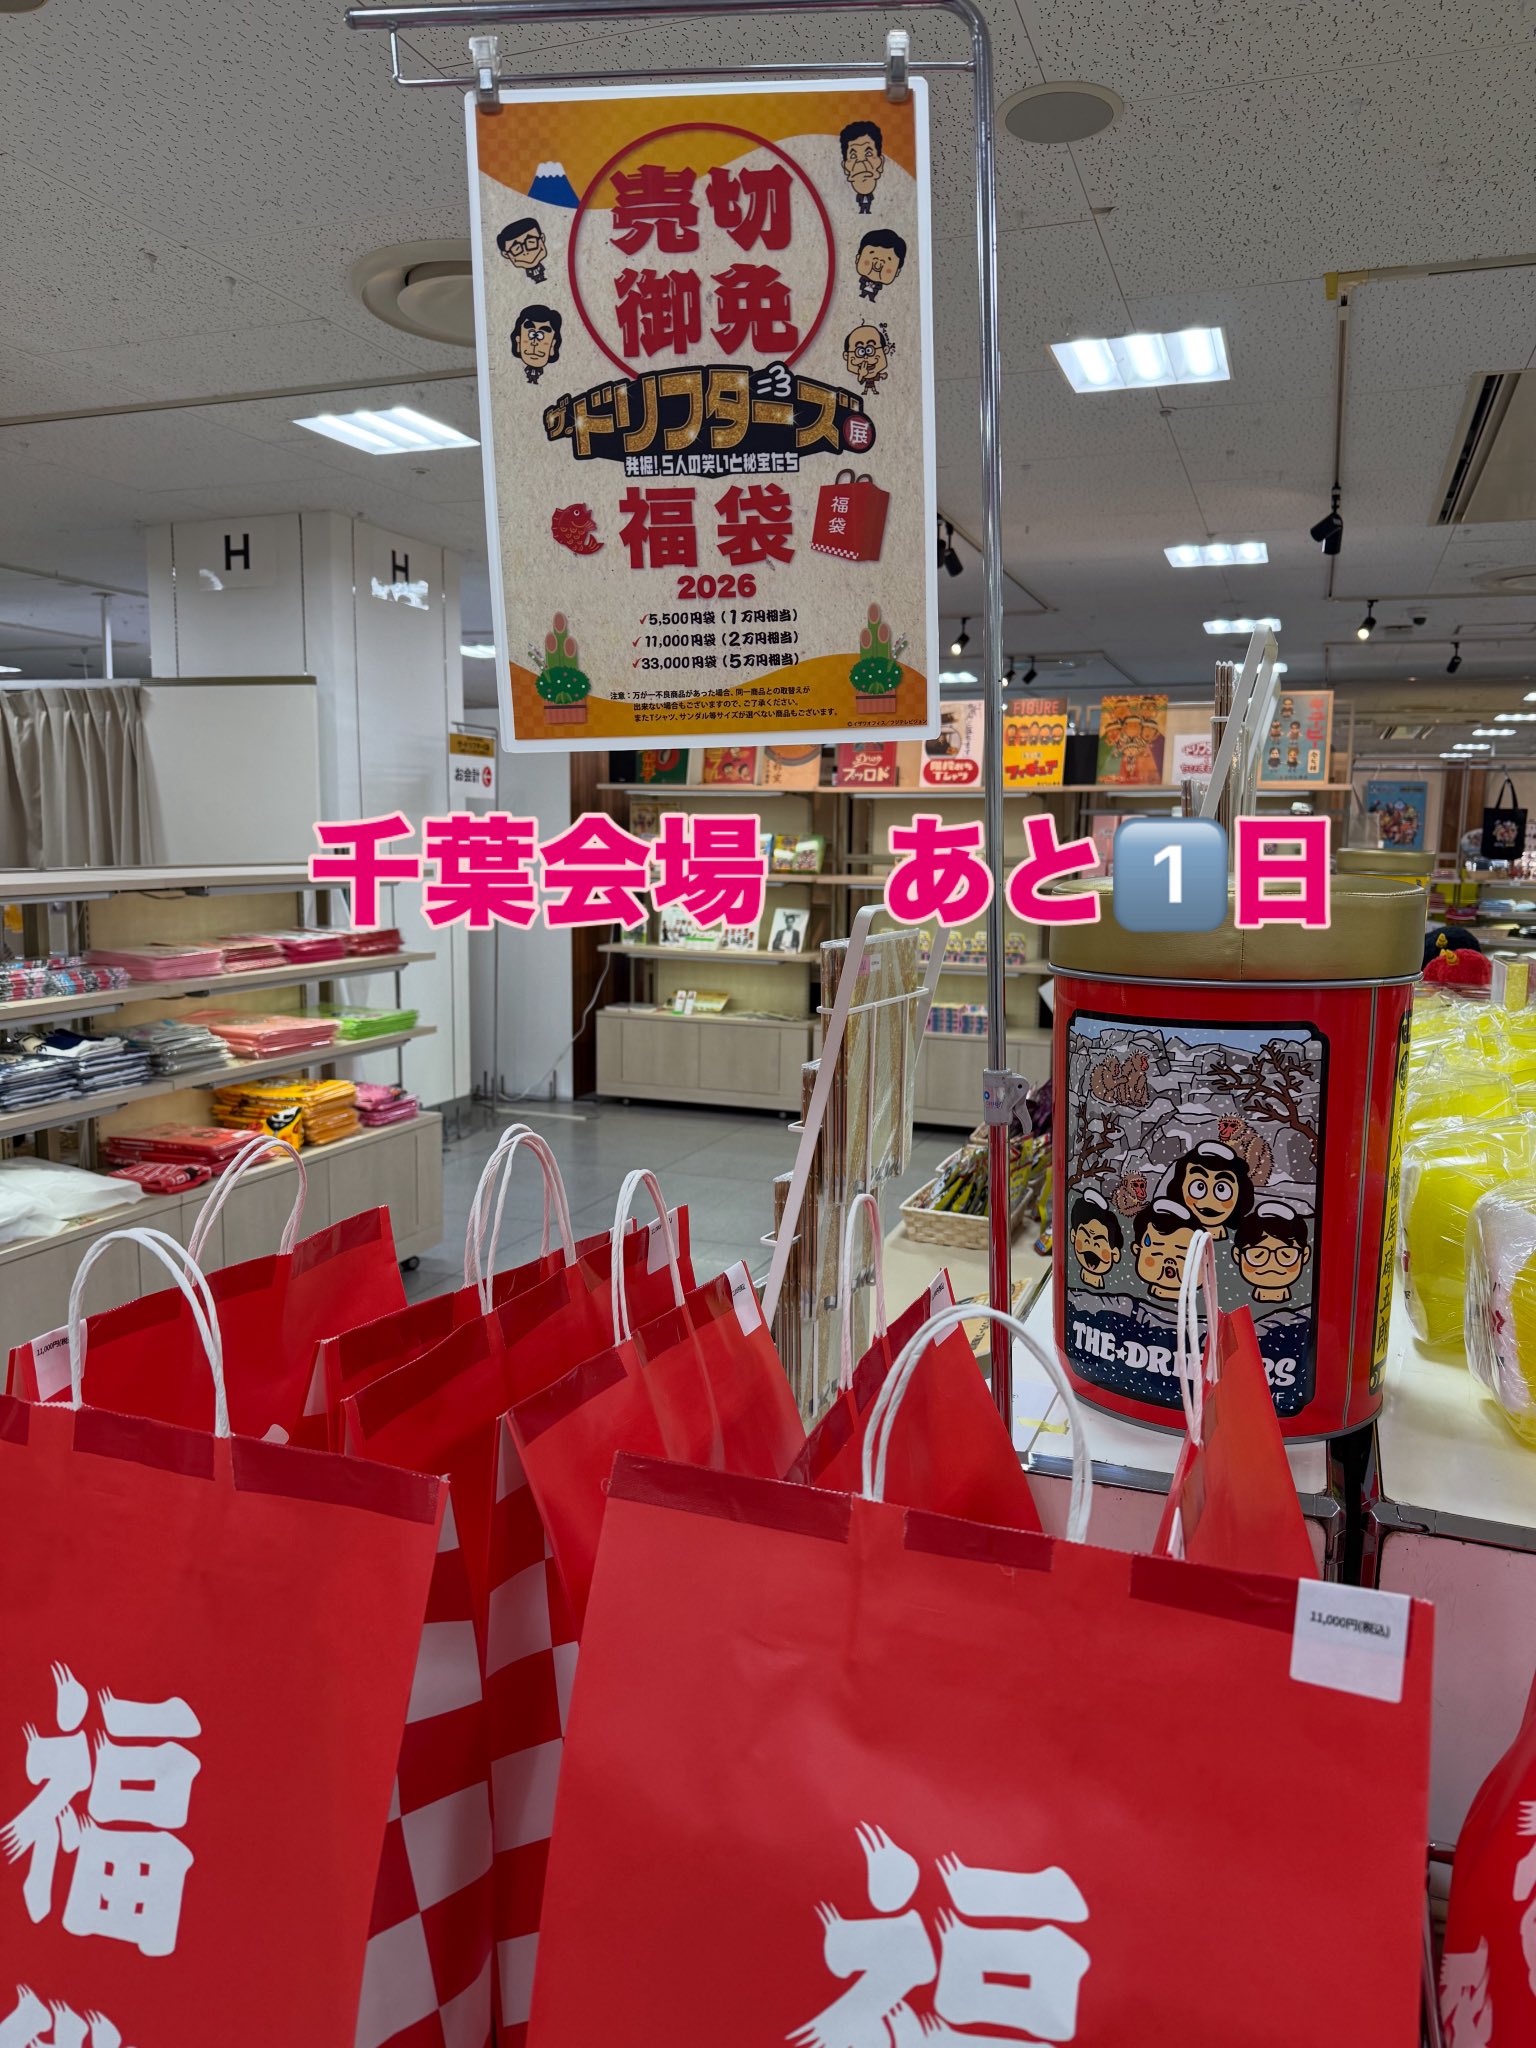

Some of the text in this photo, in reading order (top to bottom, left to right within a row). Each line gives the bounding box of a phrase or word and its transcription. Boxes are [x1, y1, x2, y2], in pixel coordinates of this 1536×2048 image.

[610, 164, 794, 256] 売切
[614, 262, 799, 358] 御免
[619, 482, 796, 570] 福袋
[827, 495, 850, 535] 福袋
[224, 533, 251, 571] H
[391, 550, 410, 583] H
[677, 573, 757, 599] 2026
[1012, 700, 1059, 714] FIGURE
[1004, 759, 1059, 780] フィギュア
[1073, 1321, 1117, 1362] THE
[1, 1660, 202, 2048] 福
